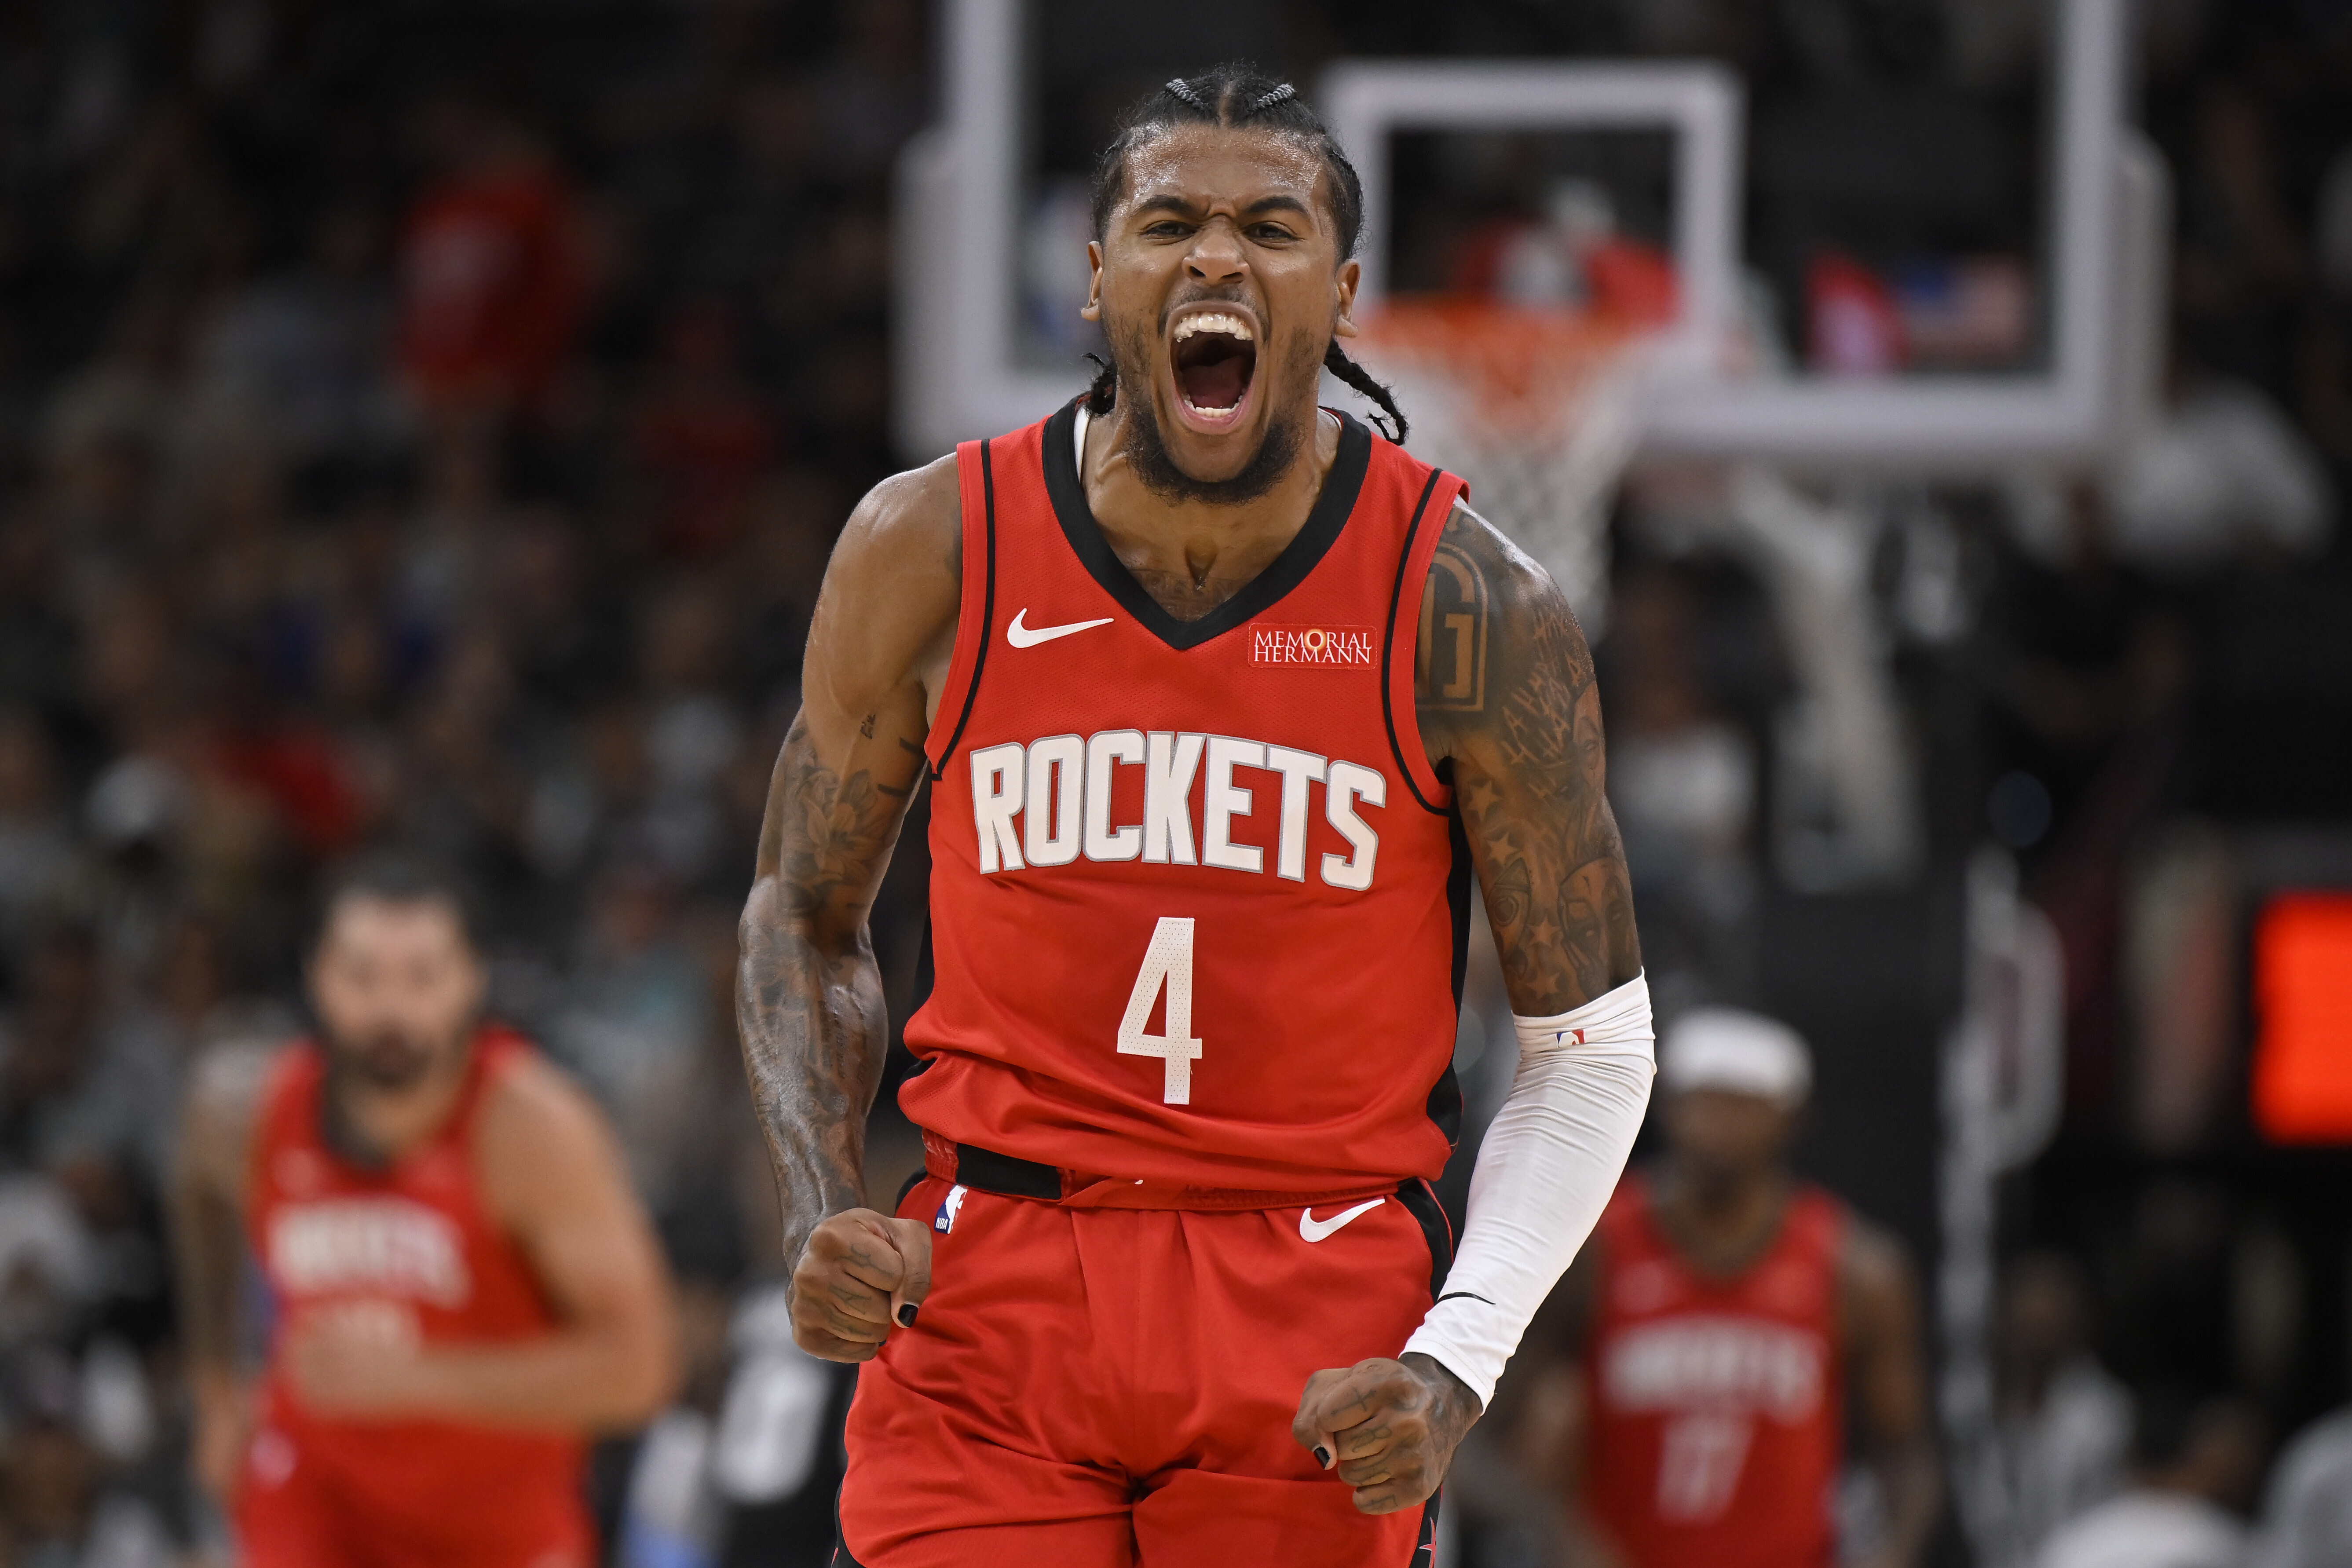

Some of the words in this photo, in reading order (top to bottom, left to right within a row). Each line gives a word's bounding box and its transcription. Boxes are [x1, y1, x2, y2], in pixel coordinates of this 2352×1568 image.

[1255, 630, 1372, 649] MEMORIAL
[1254, 646, 1370, 664] HERMANN
[970, 729, 1386, 891] ROCKETS
[1117, 917, 1202, 1105] 4
[936, 1217, 948, 1230] NBA
